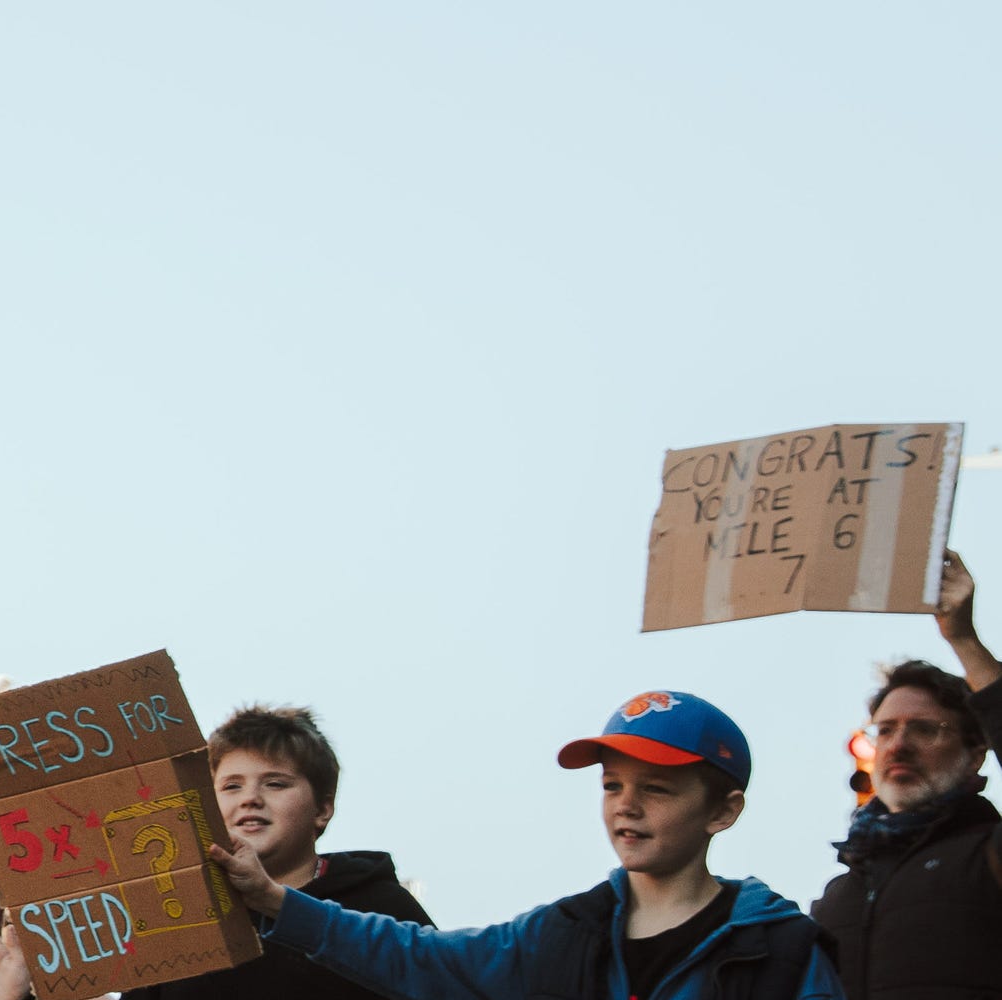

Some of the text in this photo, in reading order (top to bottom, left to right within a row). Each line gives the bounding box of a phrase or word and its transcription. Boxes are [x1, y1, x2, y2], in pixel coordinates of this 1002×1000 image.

[662, 429, 942, 493] CONGRATS!
[827, 476, 880, 505] AT
[703, 513, 860, 559] MILE 6
[779, 553, 807, 595] 7
[117, 694, 184, 740] FOR
[19, 892, 134, 974] SPEED
